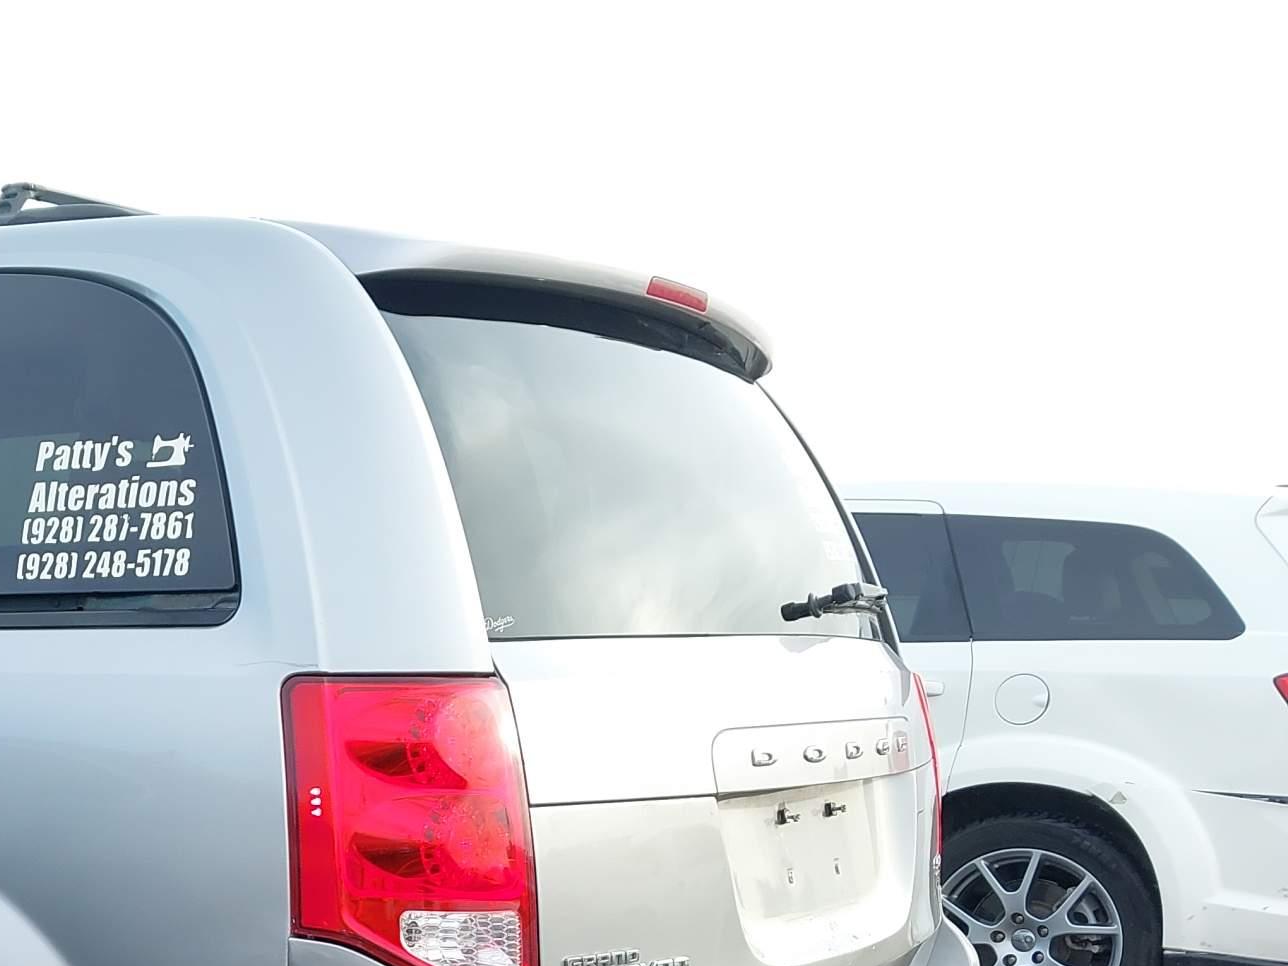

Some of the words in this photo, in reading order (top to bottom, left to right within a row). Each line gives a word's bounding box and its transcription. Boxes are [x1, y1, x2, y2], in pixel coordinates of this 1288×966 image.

[35, 436, 134, 472] Patty's
[28, 475, 197, 513] Alterations
[21, 515, 84, 545] (928)
[16, 551, 79, 581] (928)
[82, 548, 191, 579] 248-5178
[750, 736, 909, 768] DODGE
